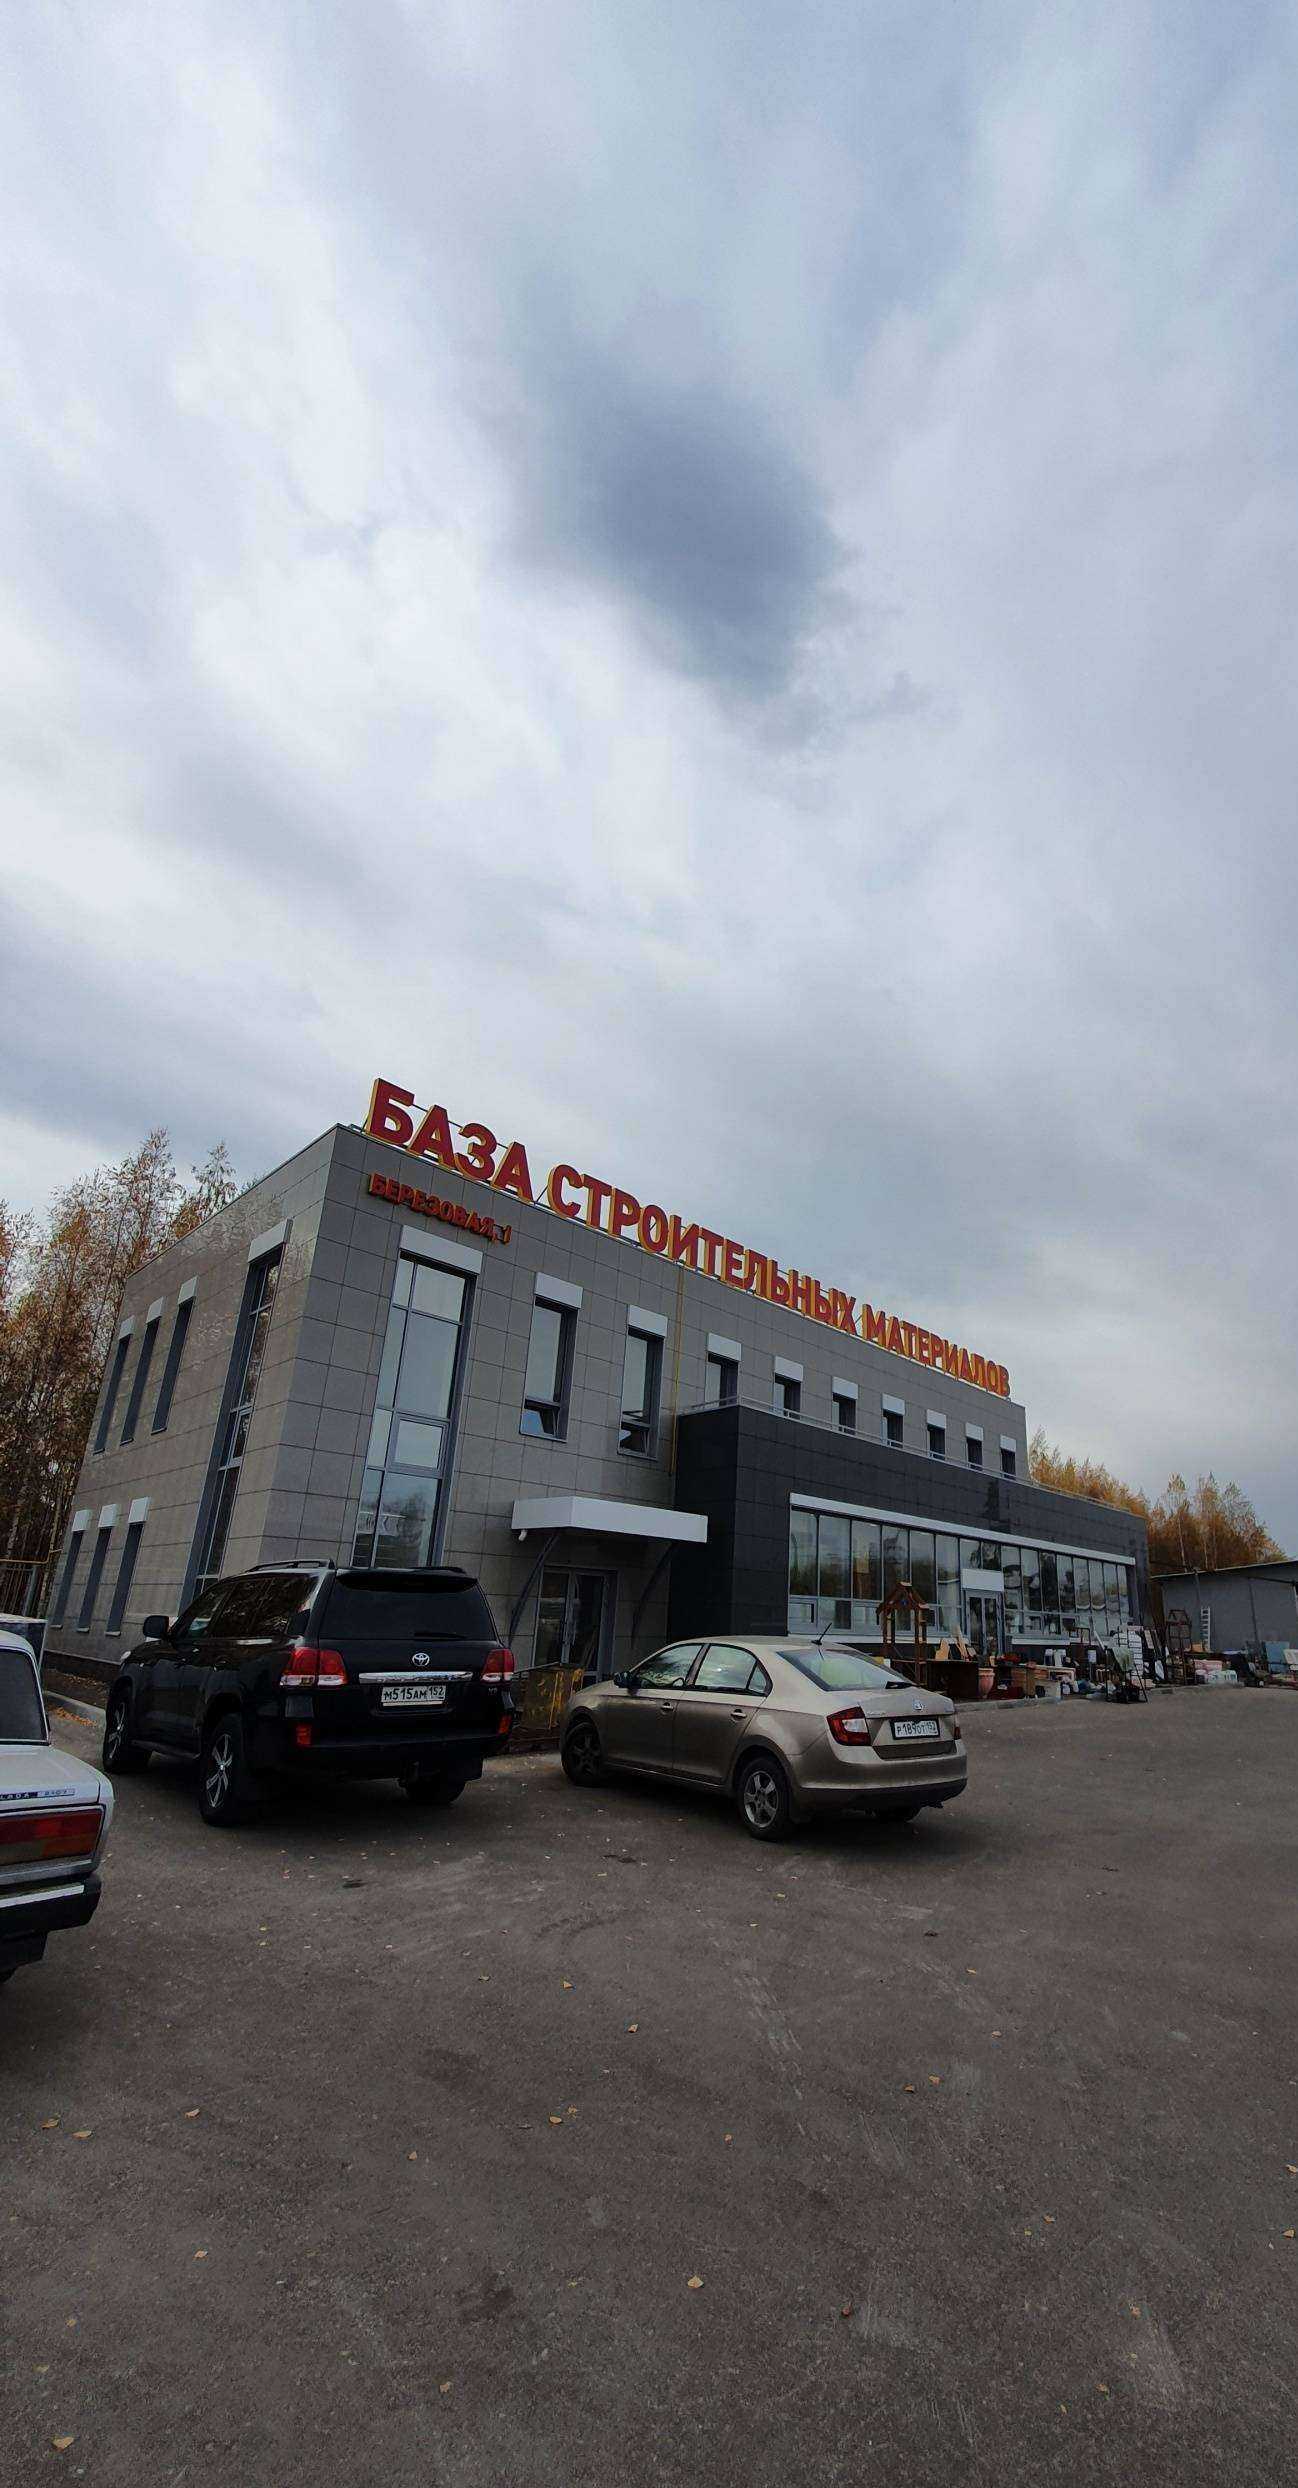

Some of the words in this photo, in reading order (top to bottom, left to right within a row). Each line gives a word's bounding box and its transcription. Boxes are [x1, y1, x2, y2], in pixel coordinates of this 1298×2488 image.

[364, 1078, 533, 1206] БАЗА
[547, 1164, 858, 1336] СТРОИТЕЛЬНЫХ
[861, 1303, 1011, 1398] МАТЕРИАЛОВ
